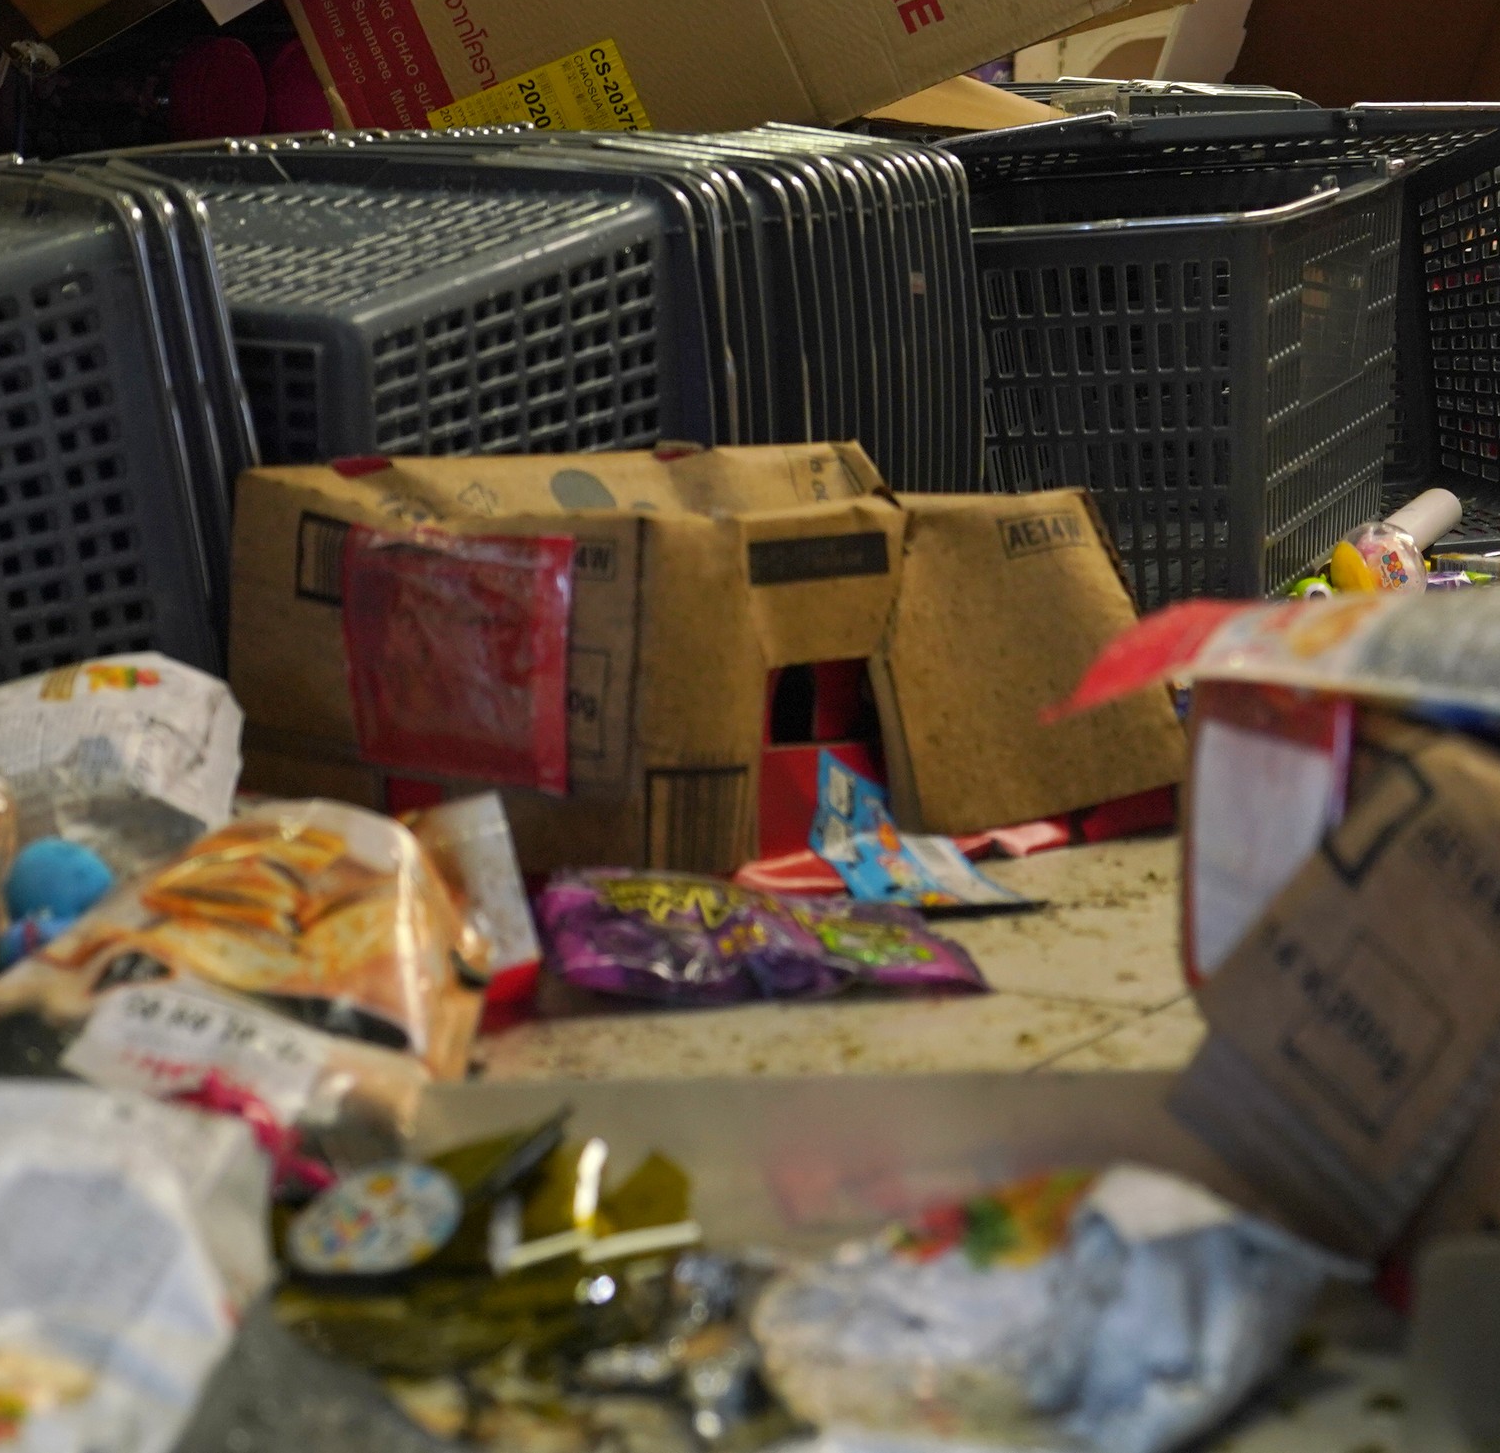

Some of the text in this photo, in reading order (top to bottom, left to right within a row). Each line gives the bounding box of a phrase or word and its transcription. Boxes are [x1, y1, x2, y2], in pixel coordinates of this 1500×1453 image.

[387, 23, 422, 78] (CHAO
[573, 54, 603, 112] CHAOSUA
[1009, 517, 1083, 551] AE14W
